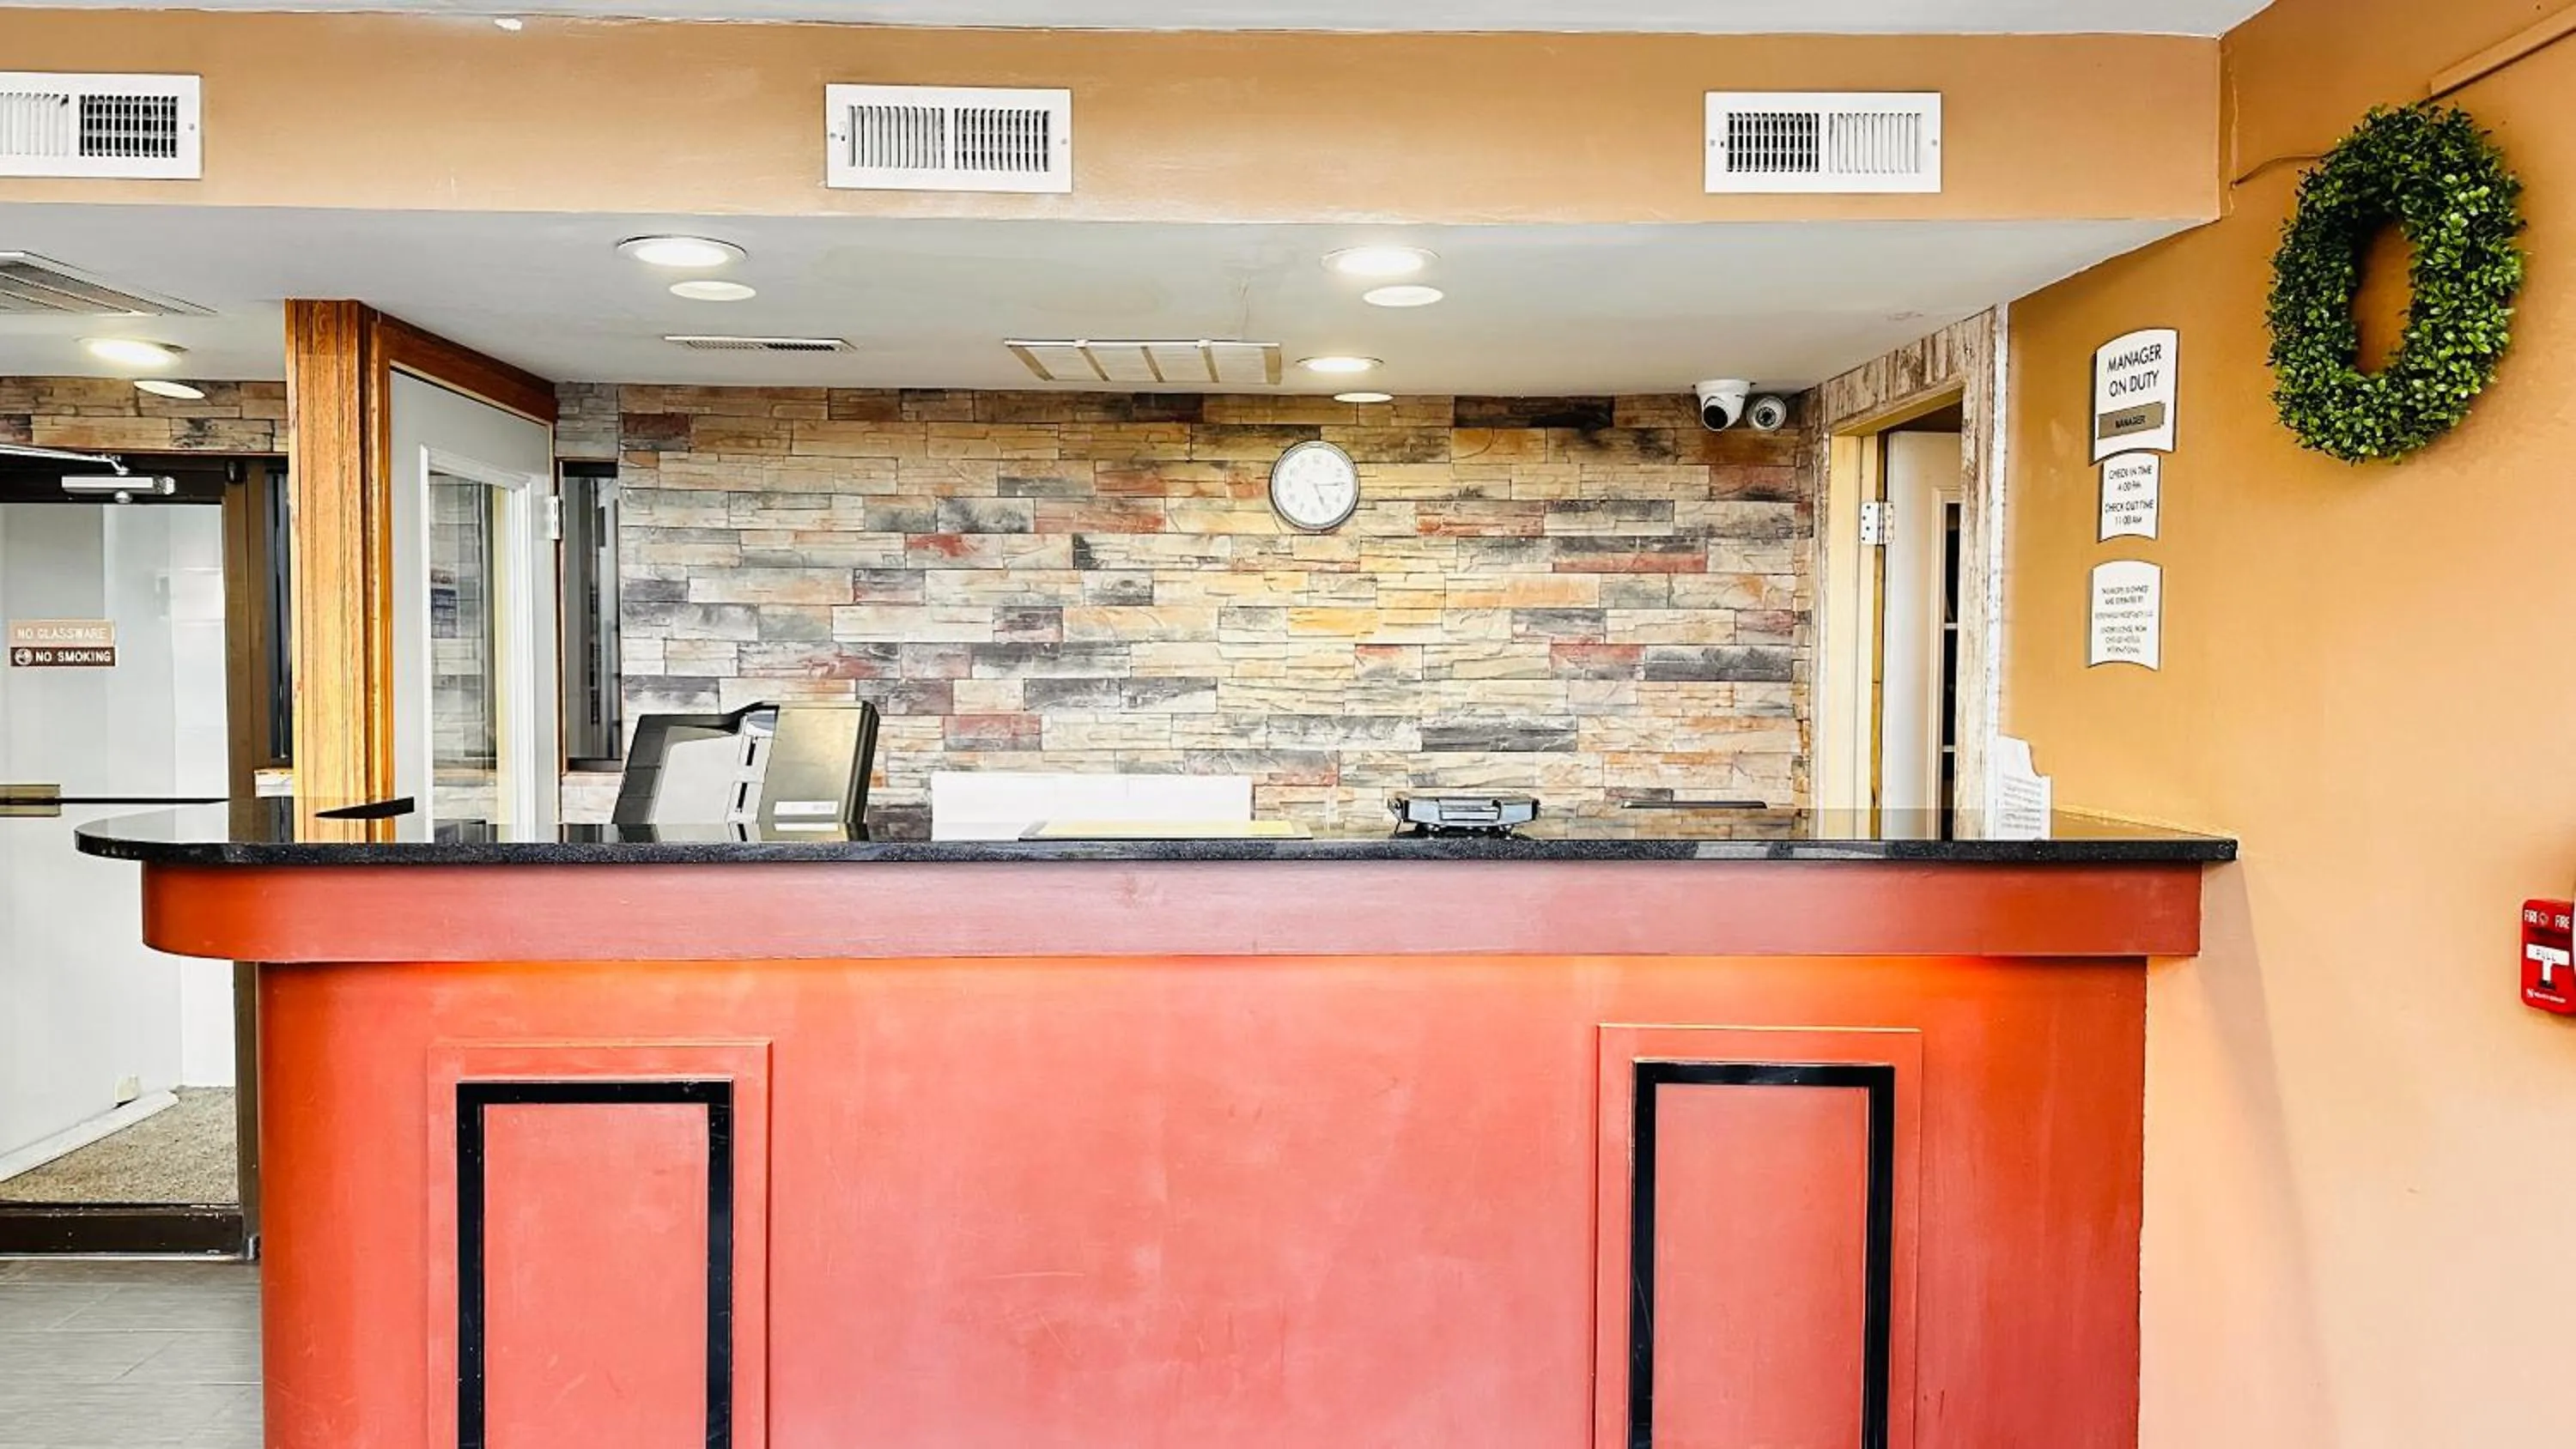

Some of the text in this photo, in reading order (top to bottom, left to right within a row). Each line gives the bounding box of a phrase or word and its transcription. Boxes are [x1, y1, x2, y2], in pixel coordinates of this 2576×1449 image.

[2107, 343, 2161, 372] MANAGER
[2109, 370, 2159, 397] ON DUTY
[17, 627, 107, 640] NO GLASSWARE
[35, 651, 112, 663] NO SMOKING
